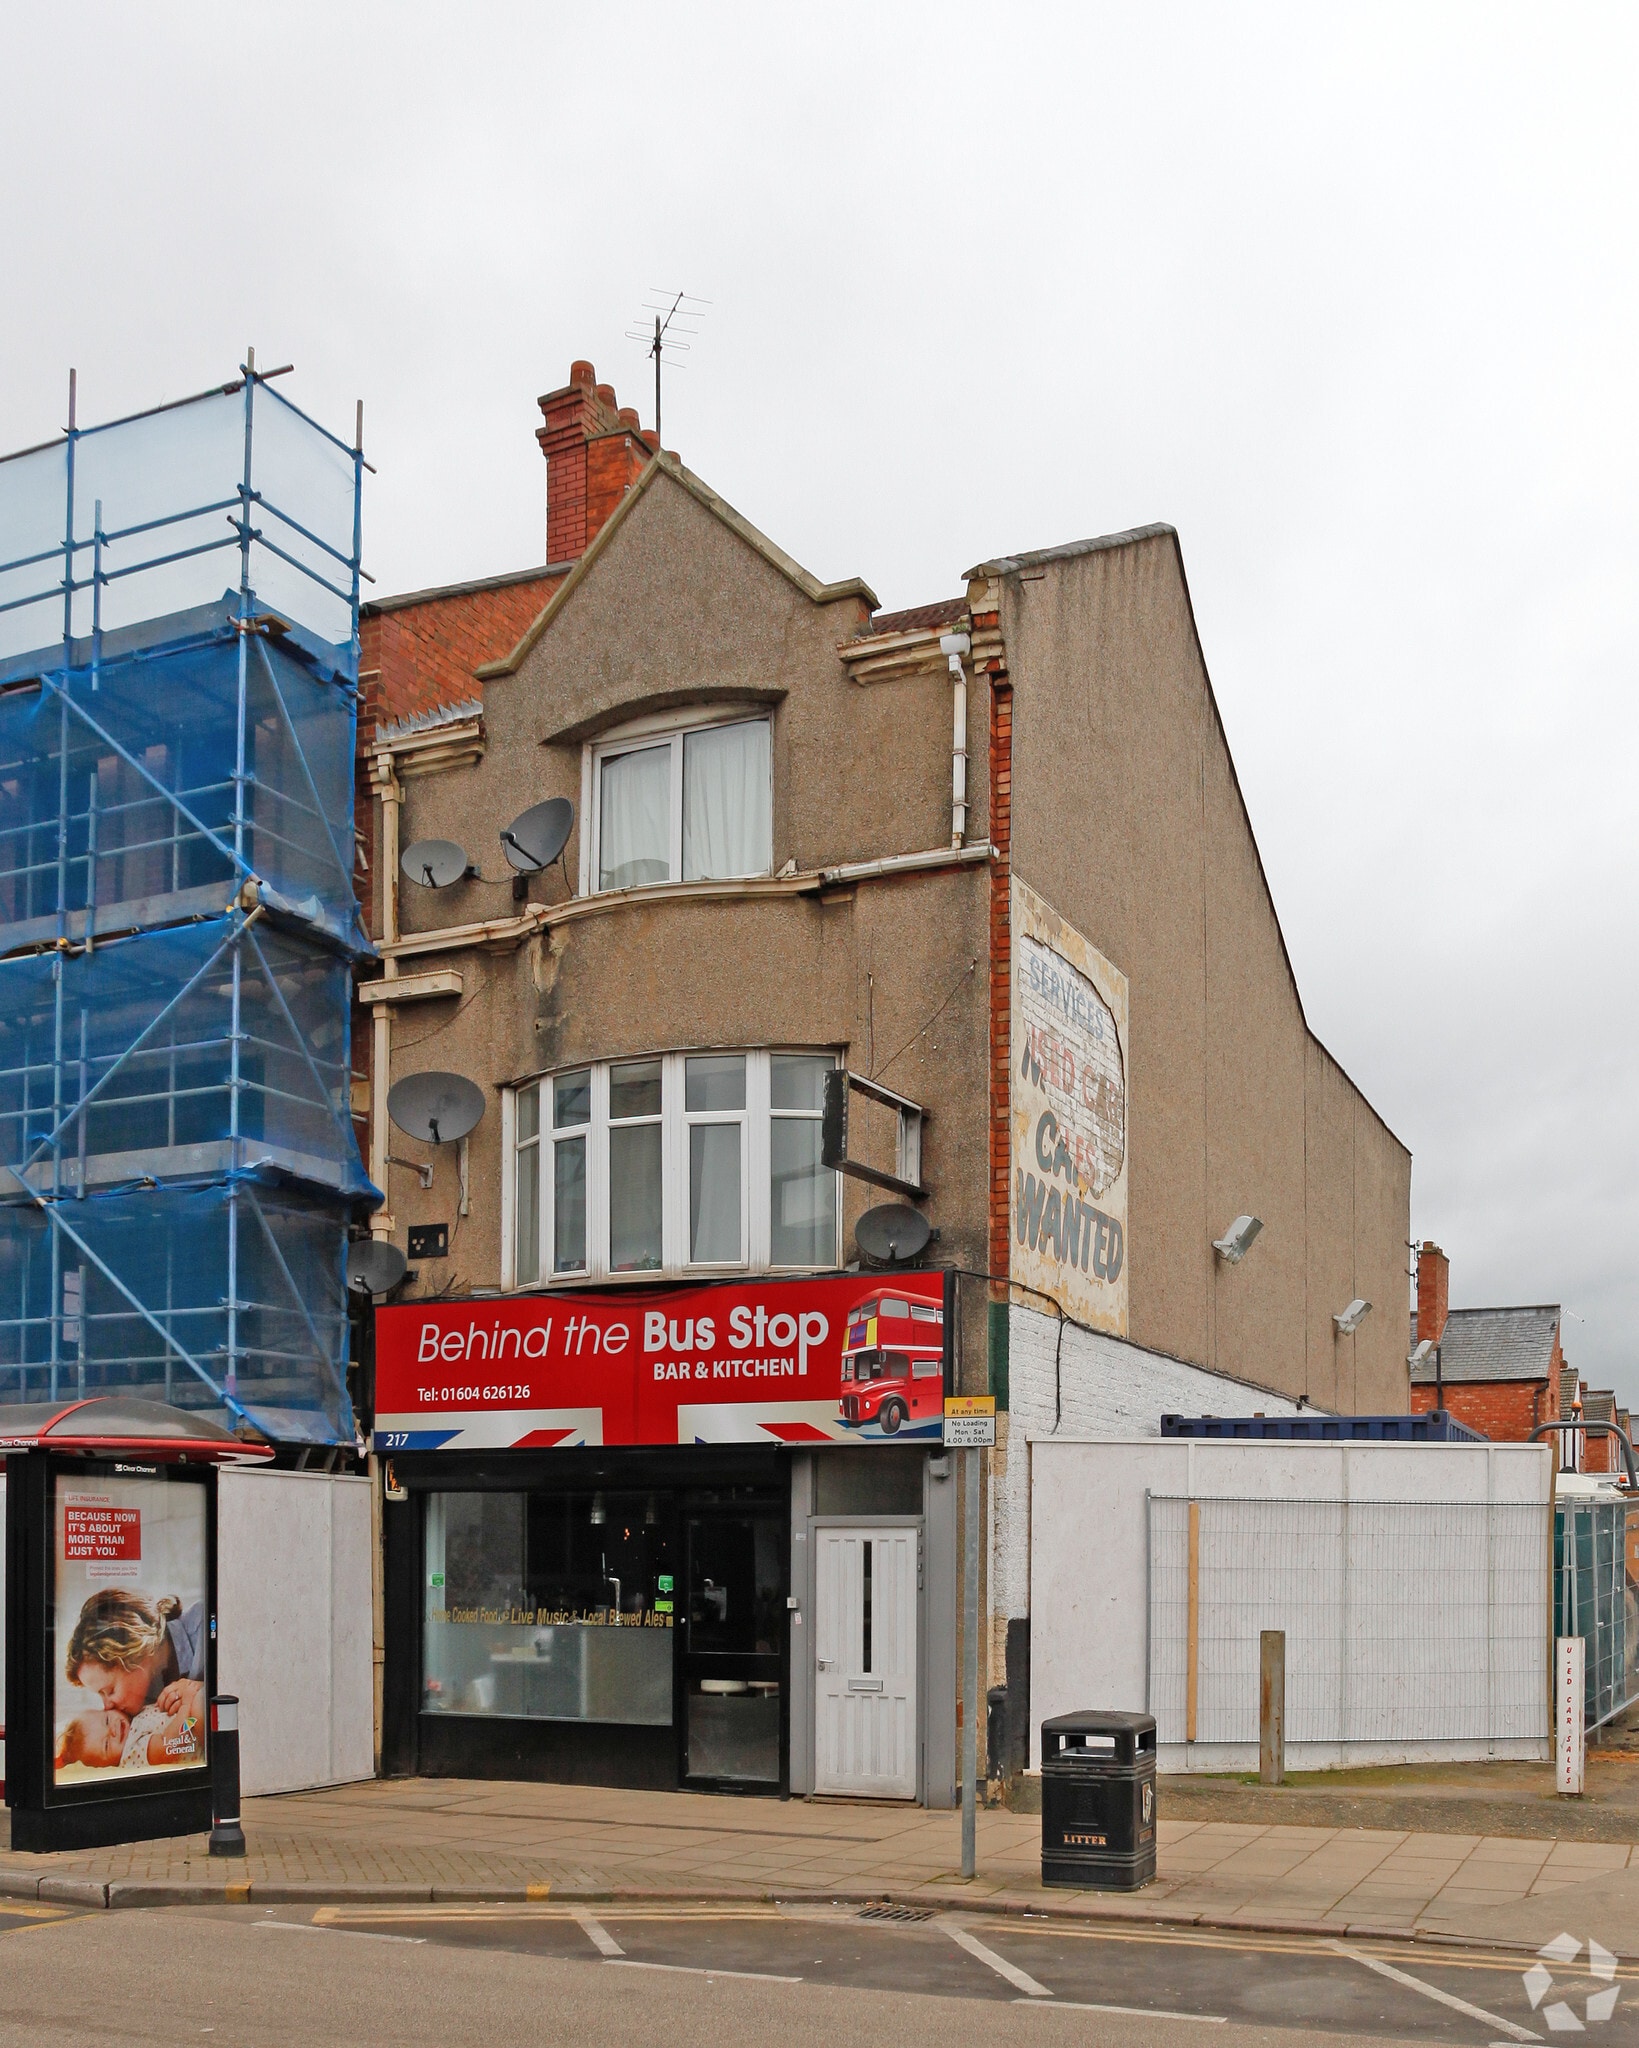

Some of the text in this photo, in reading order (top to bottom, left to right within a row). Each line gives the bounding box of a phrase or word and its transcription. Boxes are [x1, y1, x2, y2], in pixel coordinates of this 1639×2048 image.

[1030, 956, 1104, 1040] SERVICES
[1017, 1167, 1123, 1284] WANTED
[418, 1305, 829, 1375] Behind the Bus Stop
[653, 1358, 794, 1380] BAR & KITCHEN
[417, 1385, 531, 1401] Tel: 01604 626126
[385, 1433, 408, 1447] 217
[122, 1464, 157, 1474] Clear Channel
[68, 1494, 111, 1503] LIFE INSURANCE
[68, 1511, 136, 1522] BECAUSE NOW
[68, 1523, 121, 1533] IT'S ABOUT
[68, 1535, 125, 1544] MORE THAN
[68, 1546, 118, 1556] JUST YOU.
[452, 1606, 478, 1623] Cooked
[480, 1607, 498, 1623] Food
[511, 1608, 534, 1625] Live
[537, 1608, 569, 1625] Music
[582, 1608, 606, 1625] Local
[644, 1609, 665, 1627] Ales
[163, 1734, 191, 1747] Legal &
[165, 1743, 195, 1755] General
[1063, 1834, 1107, 1845] LITTER
